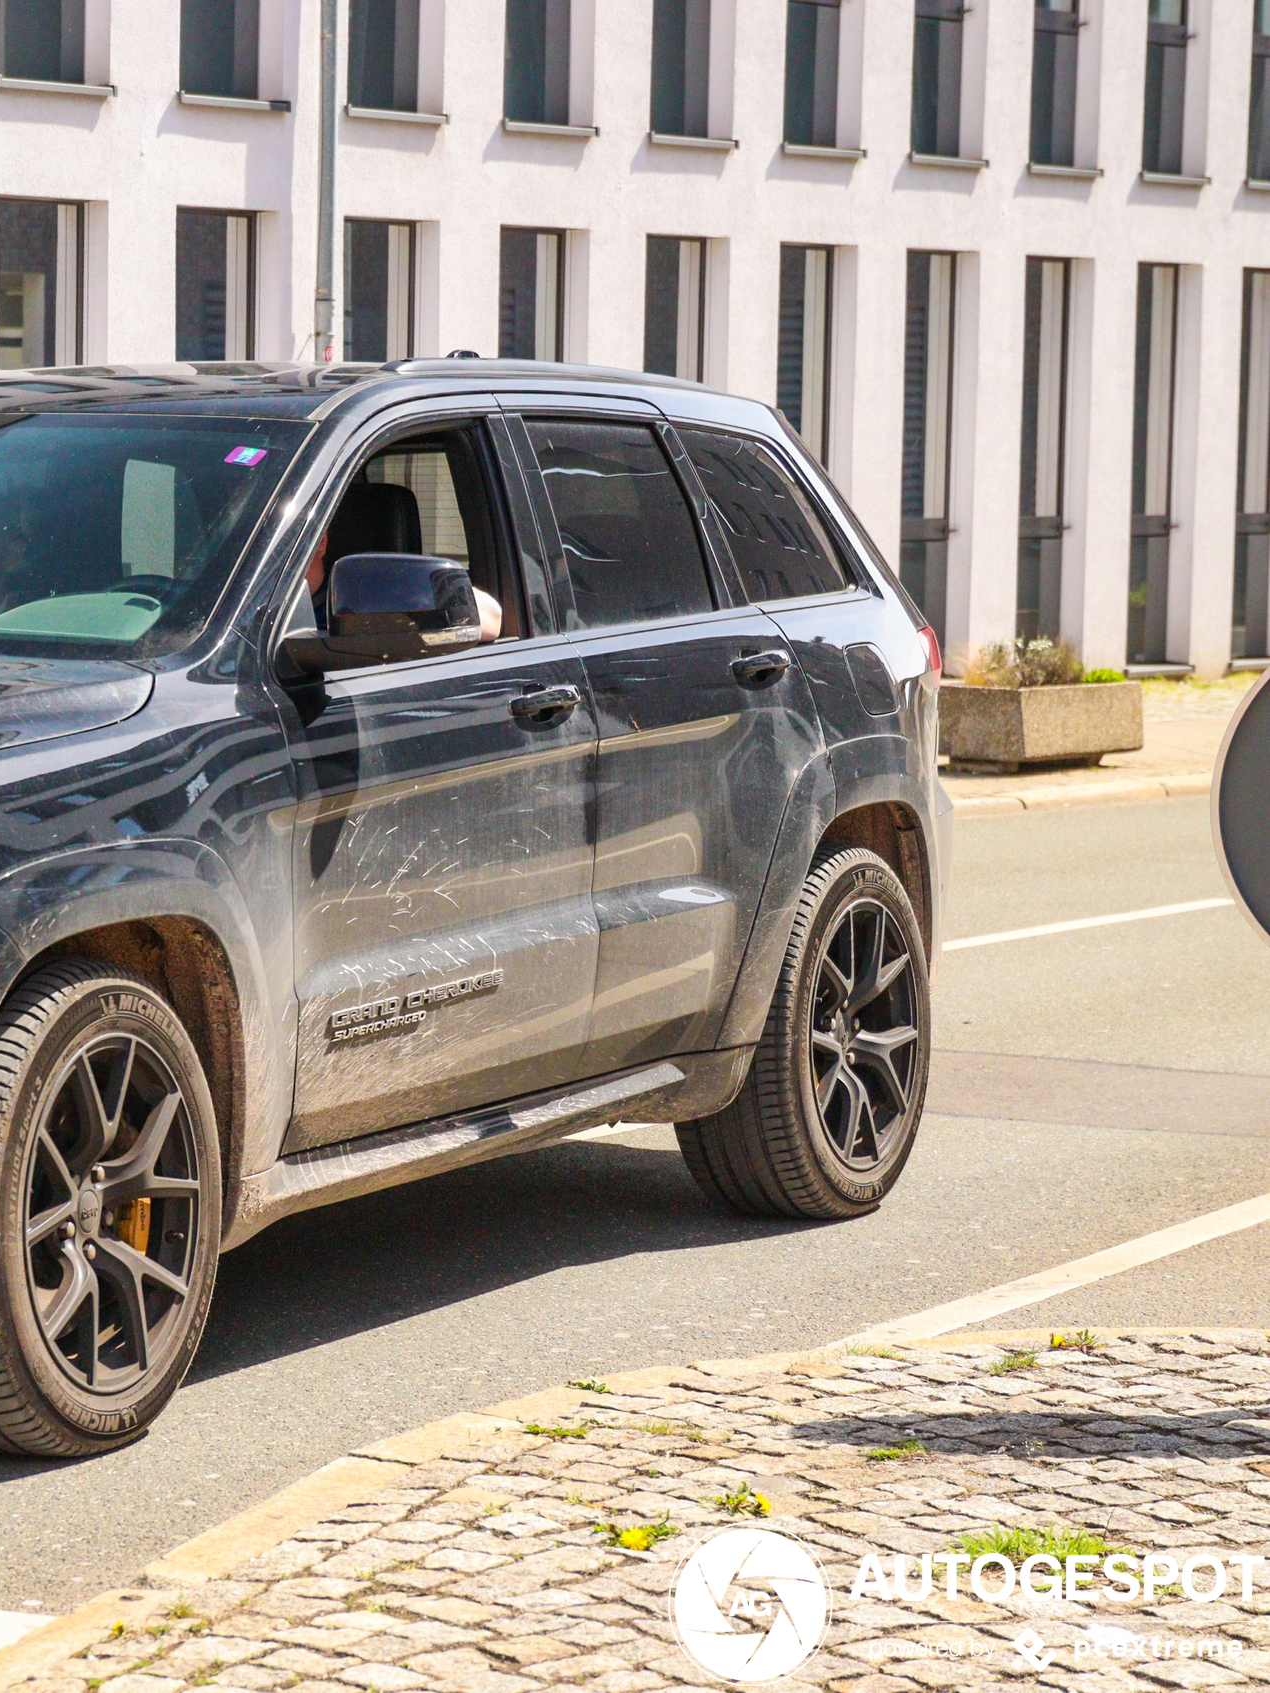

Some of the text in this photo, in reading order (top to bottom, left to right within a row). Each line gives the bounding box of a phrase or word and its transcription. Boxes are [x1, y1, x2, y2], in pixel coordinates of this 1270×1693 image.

[331, 968, 504, 1028] GRAND CHEROKEE
[331, 1009, 427, 1043] SUPERCHARGED
